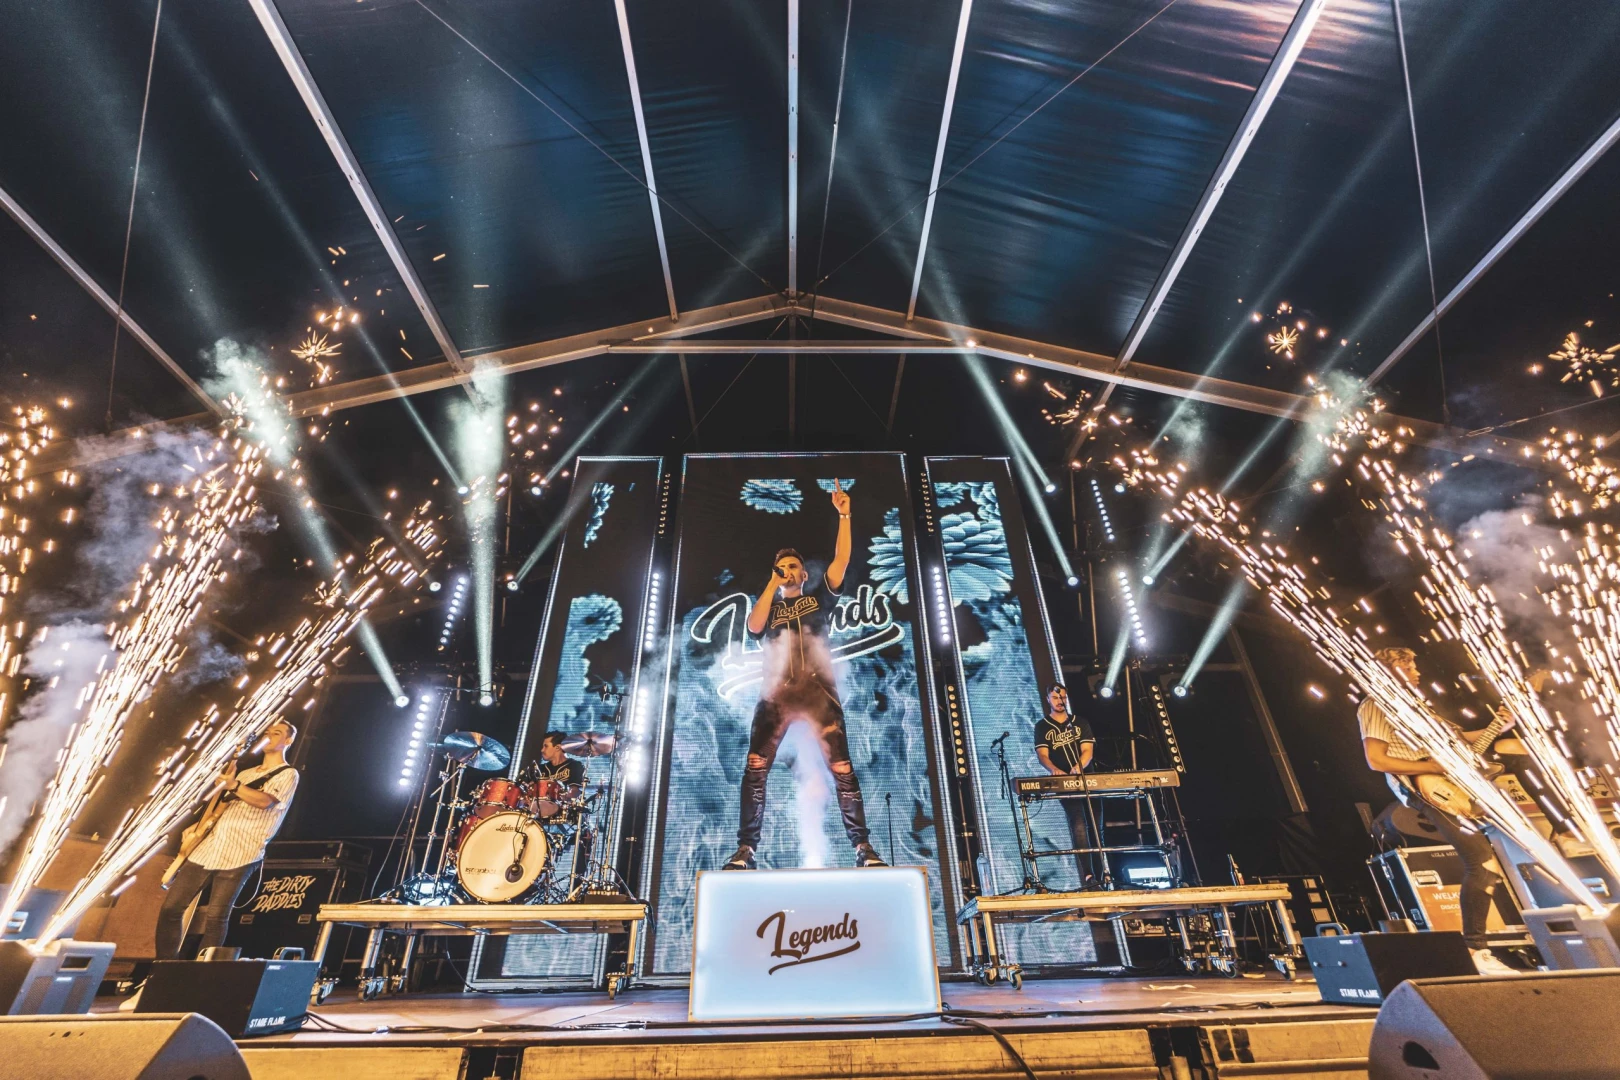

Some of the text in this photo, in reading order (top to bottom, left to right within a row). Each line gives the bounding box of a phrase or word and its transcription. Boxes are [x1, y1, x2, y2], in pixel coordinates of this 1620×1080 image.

[691, 584, 894, 668] Lnds
[1021, 782, 1040, 790] KORG
[262, 875, 316, 893] THE DIRTY
[251, 893, 305, 913] DADDIES
[756, 911, 859, 961] Legends
[1340, 989, 1380, 998] STAGE FLAME
[249, 1016, 286, 1028] STAGE FLAME
